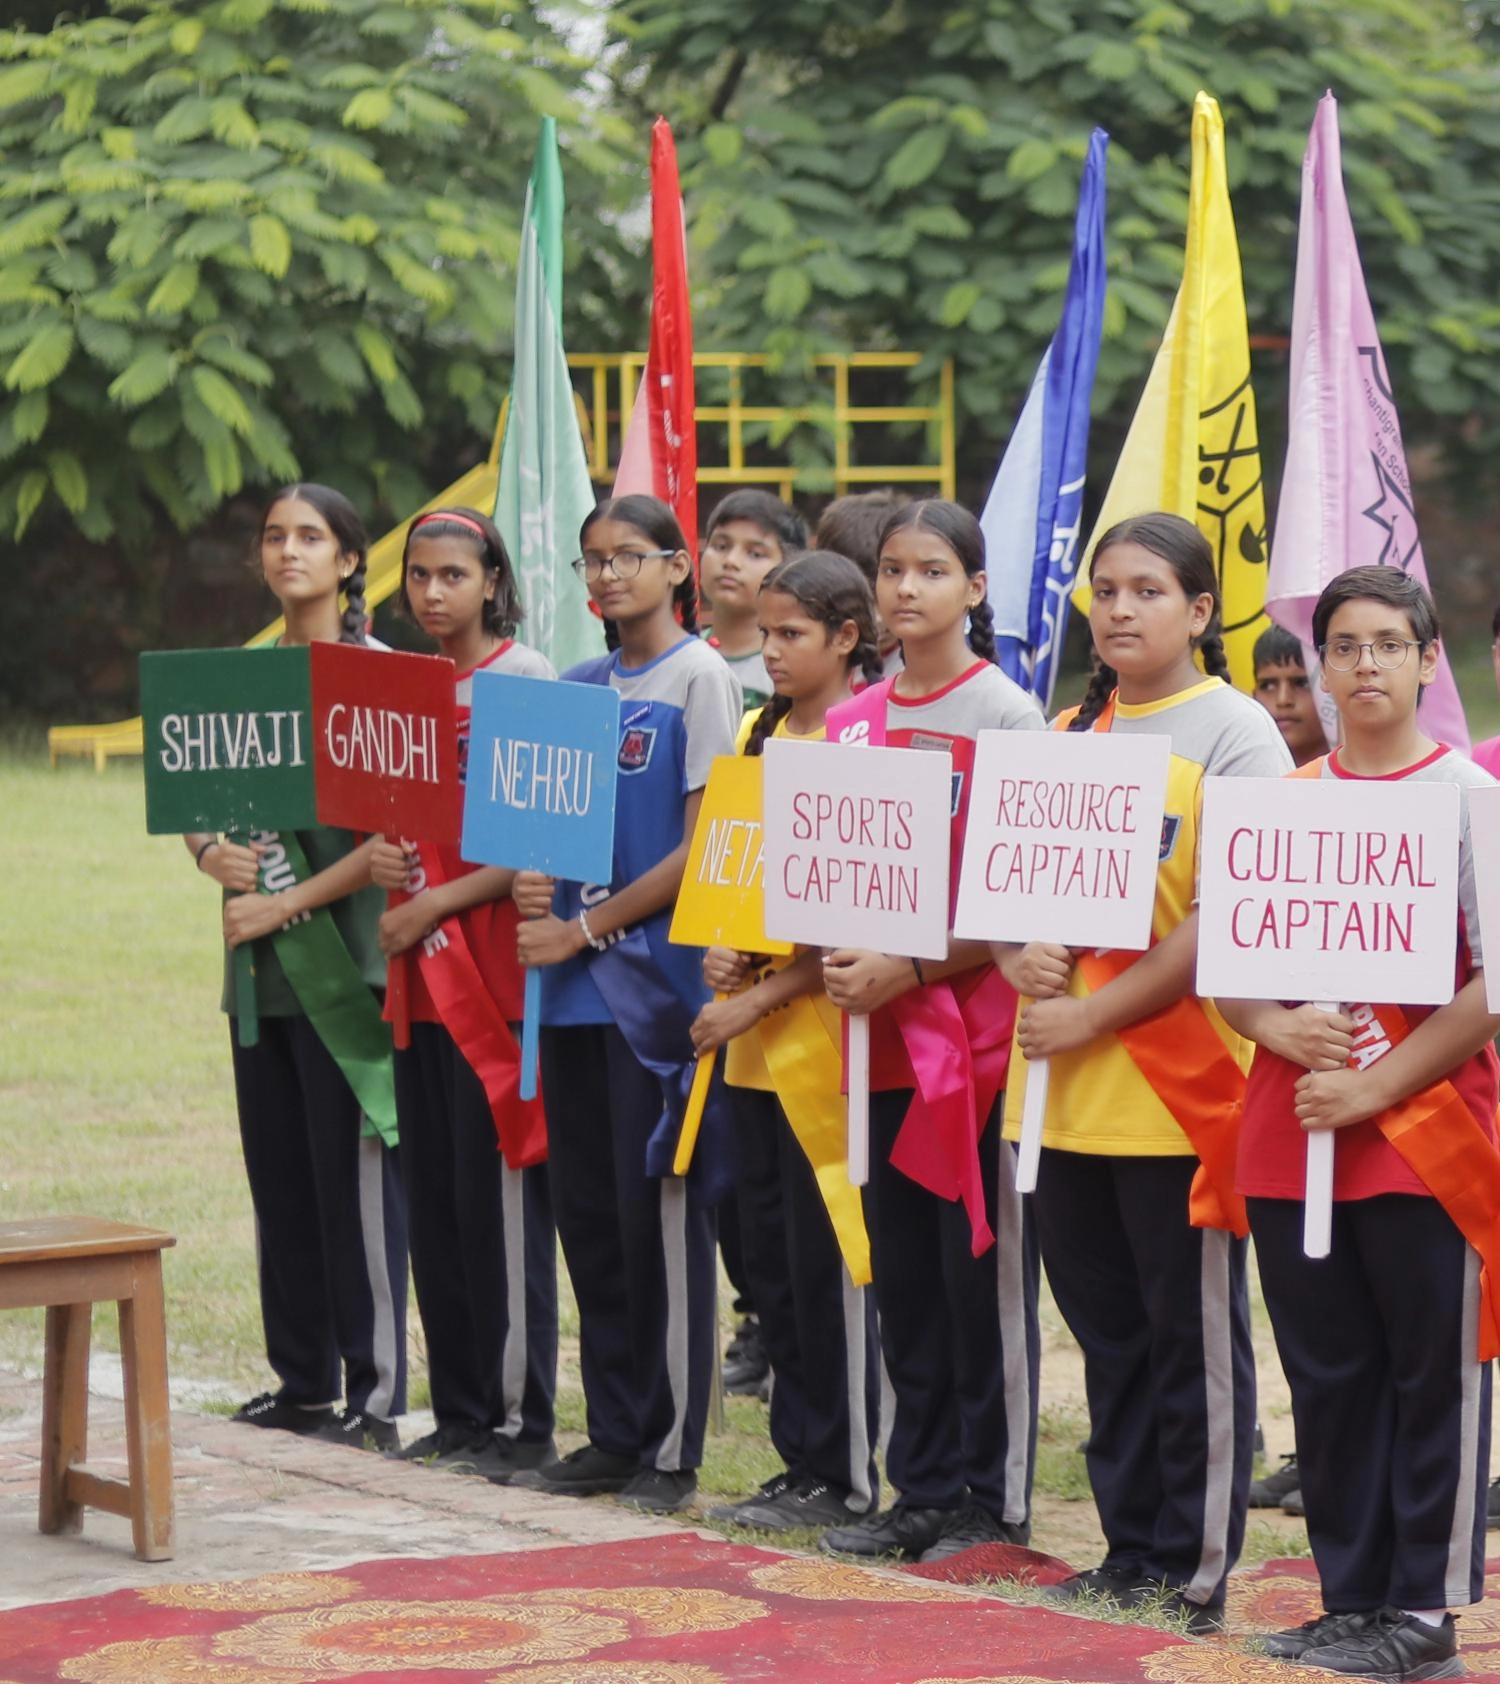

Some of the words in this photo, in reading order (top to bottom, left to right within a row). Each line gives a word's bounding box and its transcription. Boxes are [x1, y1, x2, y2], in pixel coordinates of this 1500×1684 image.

[160, 710, 306, 772] SHIVAJI
[326, 703, 439, 784] GANDHI
[490, 737, 594, 816] NEHRU
[995, 778, 1140, 833] RESOURCE
[793, 792, 912, 850] SPORTS
[783, 853, 918, 914] CAPTAIN
[985, 842, 1130, 899] CAPTAIN
[1228, 827, 1436, 887] CULTURAL
[1231, 897, 1416, 952] CAPTAIN
